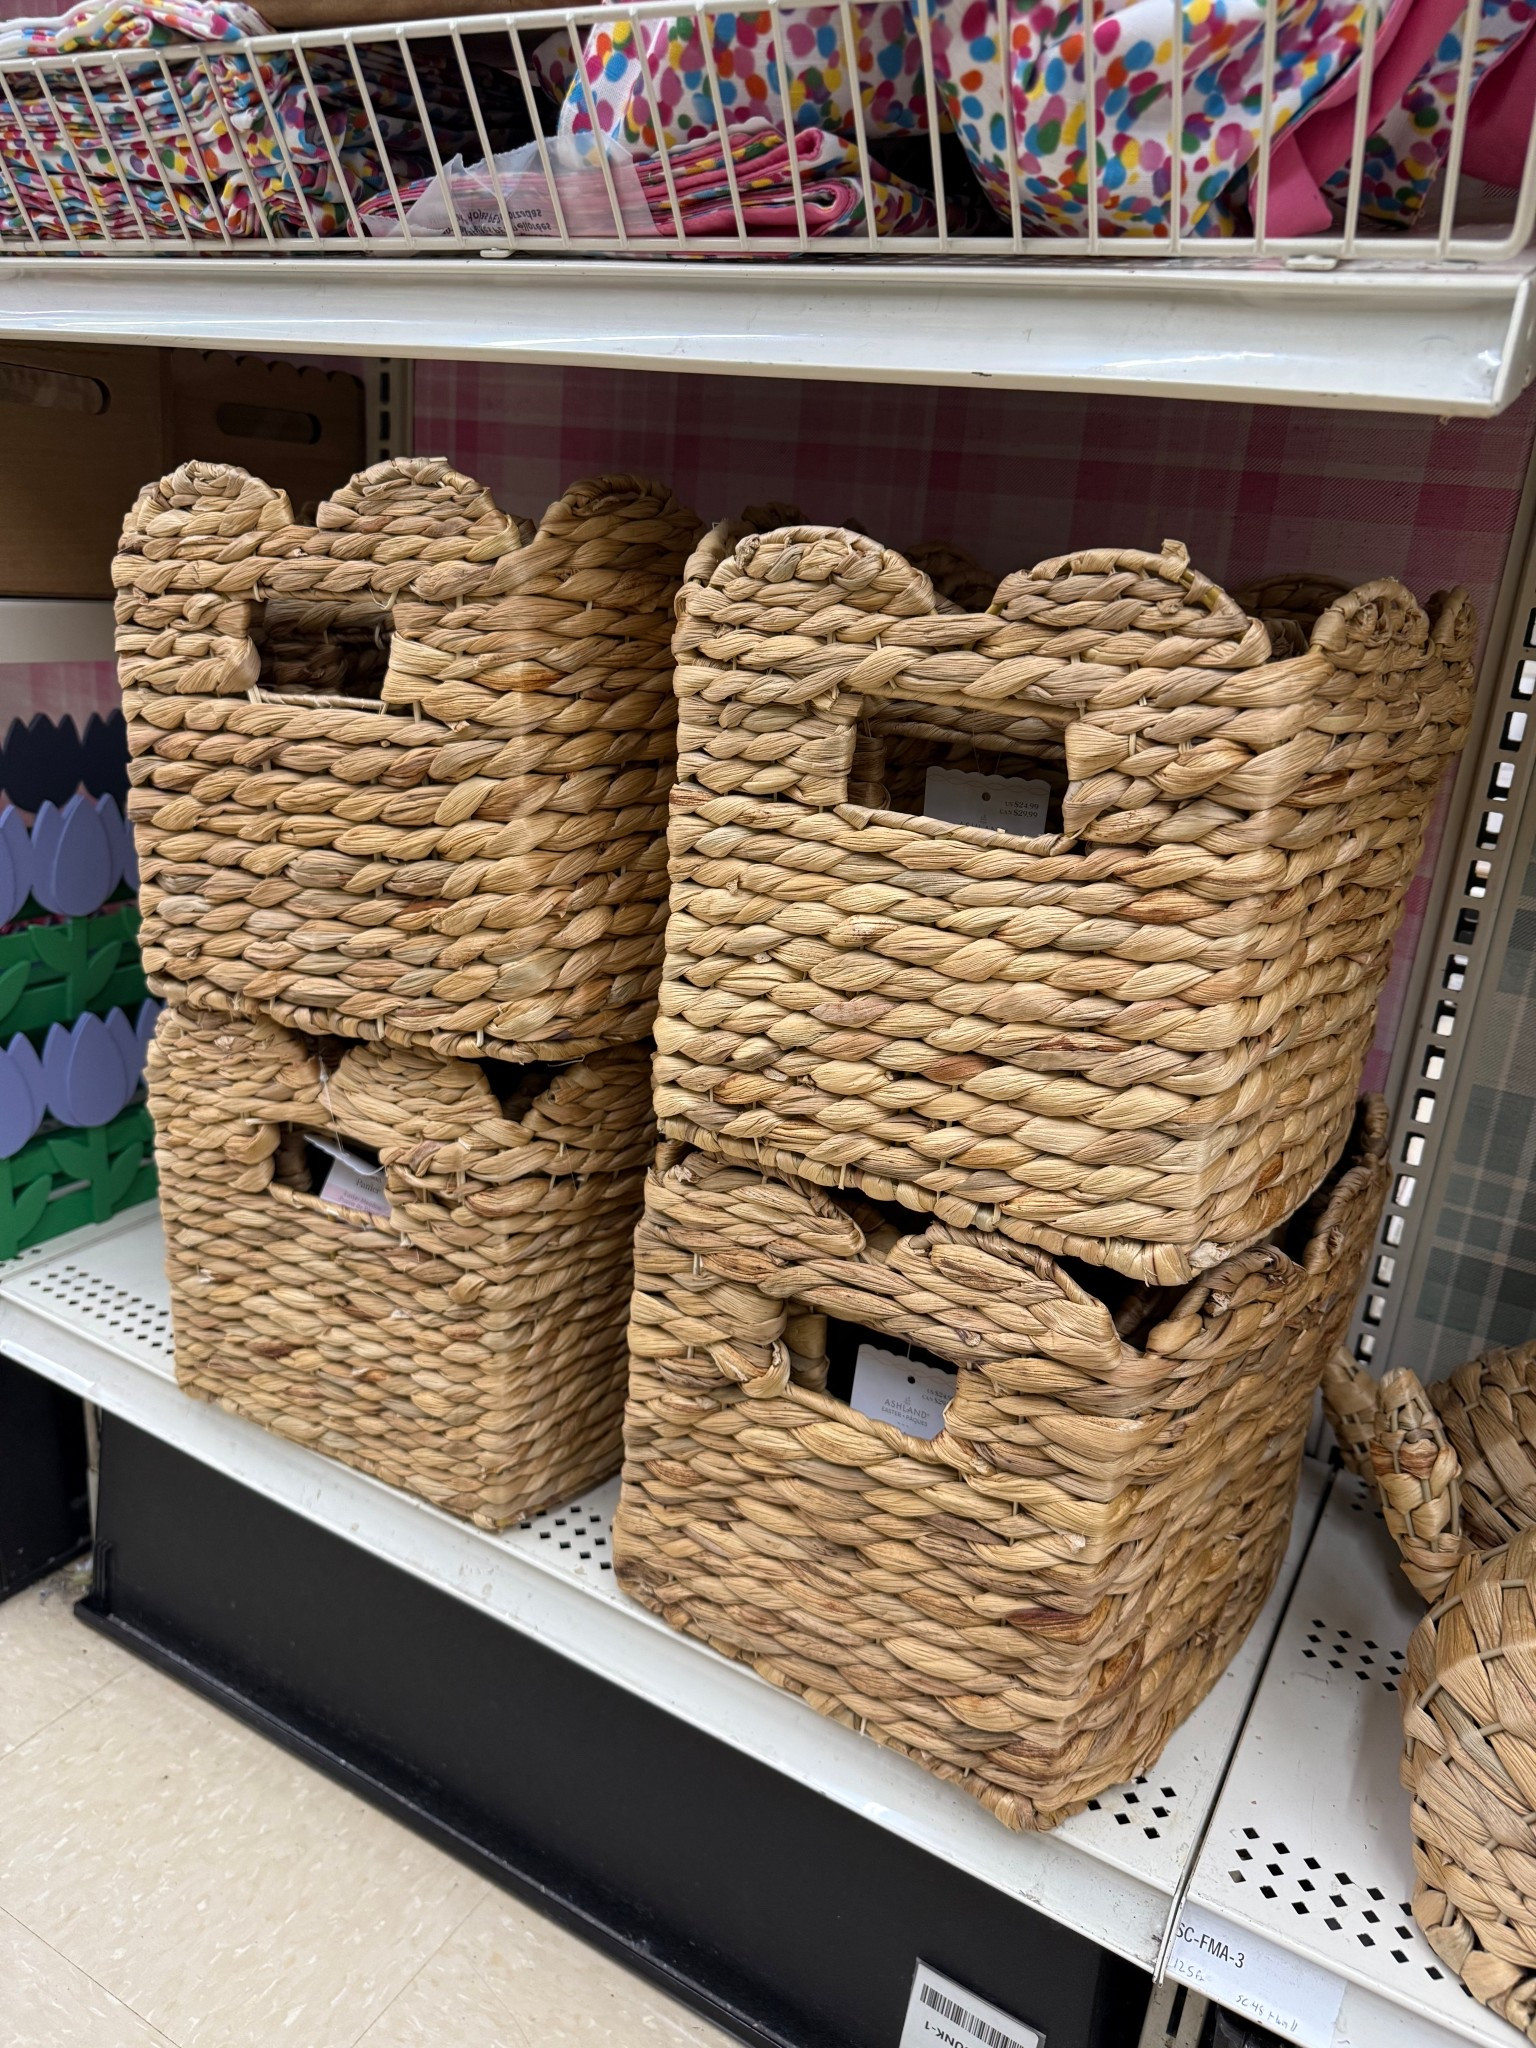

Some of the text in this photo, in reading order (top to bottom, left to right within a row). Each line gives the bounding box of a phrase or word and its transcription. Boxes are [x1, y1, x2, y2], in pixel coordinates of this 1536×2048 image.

[1000, 808, 1038, 818] CAN $29.99
[1014, 801, 1039, 810] $24.99
[356, 1179, 379, 1194] Panier
[1176, 1922, 1245, 1968] SC-FMA-3
[925, 2020, 970, 2048] UNK-1
